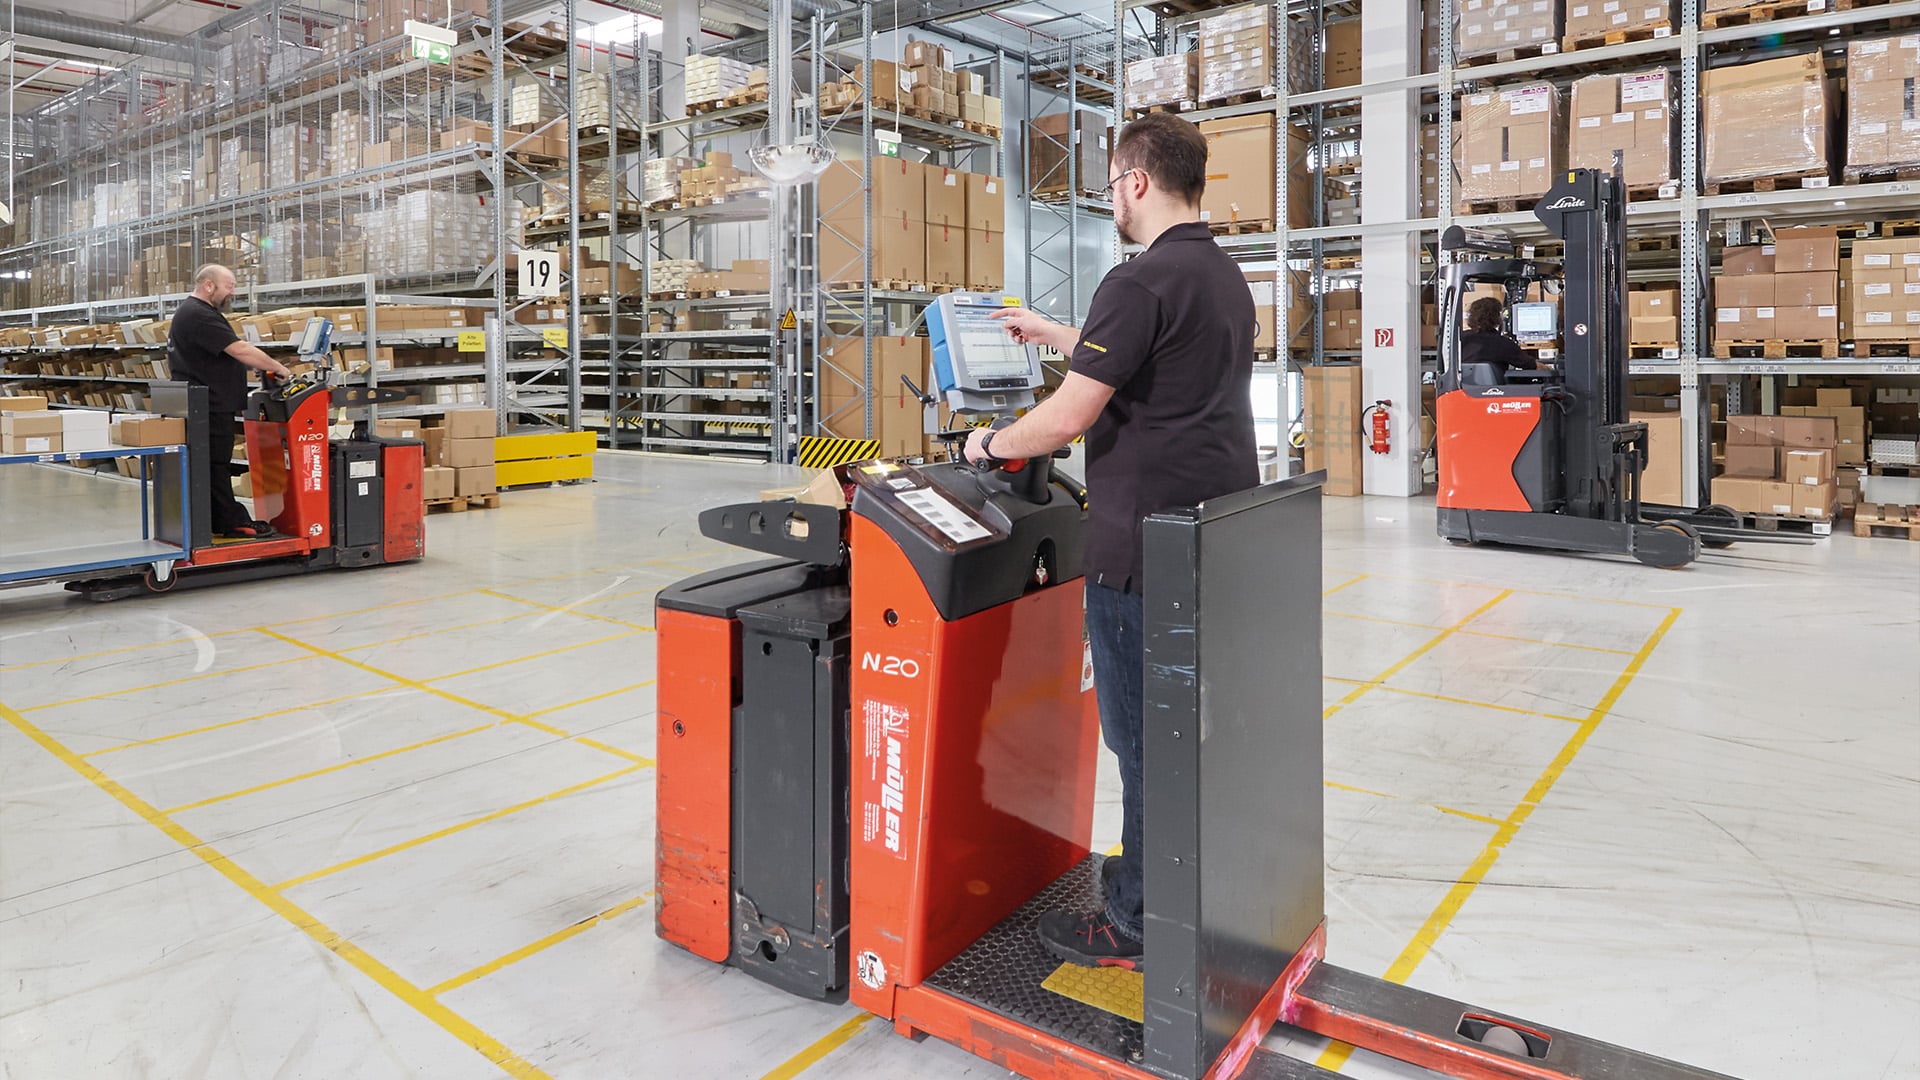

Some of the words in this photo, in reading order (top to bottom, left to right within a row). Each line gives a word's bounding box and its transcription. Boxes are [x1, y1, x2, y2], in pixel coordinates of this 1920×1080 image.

[1546, 196, 1585, 209] Linde
[526, 259, 550, 287] 19
[881, 735, 904, 853] MÜLLER
